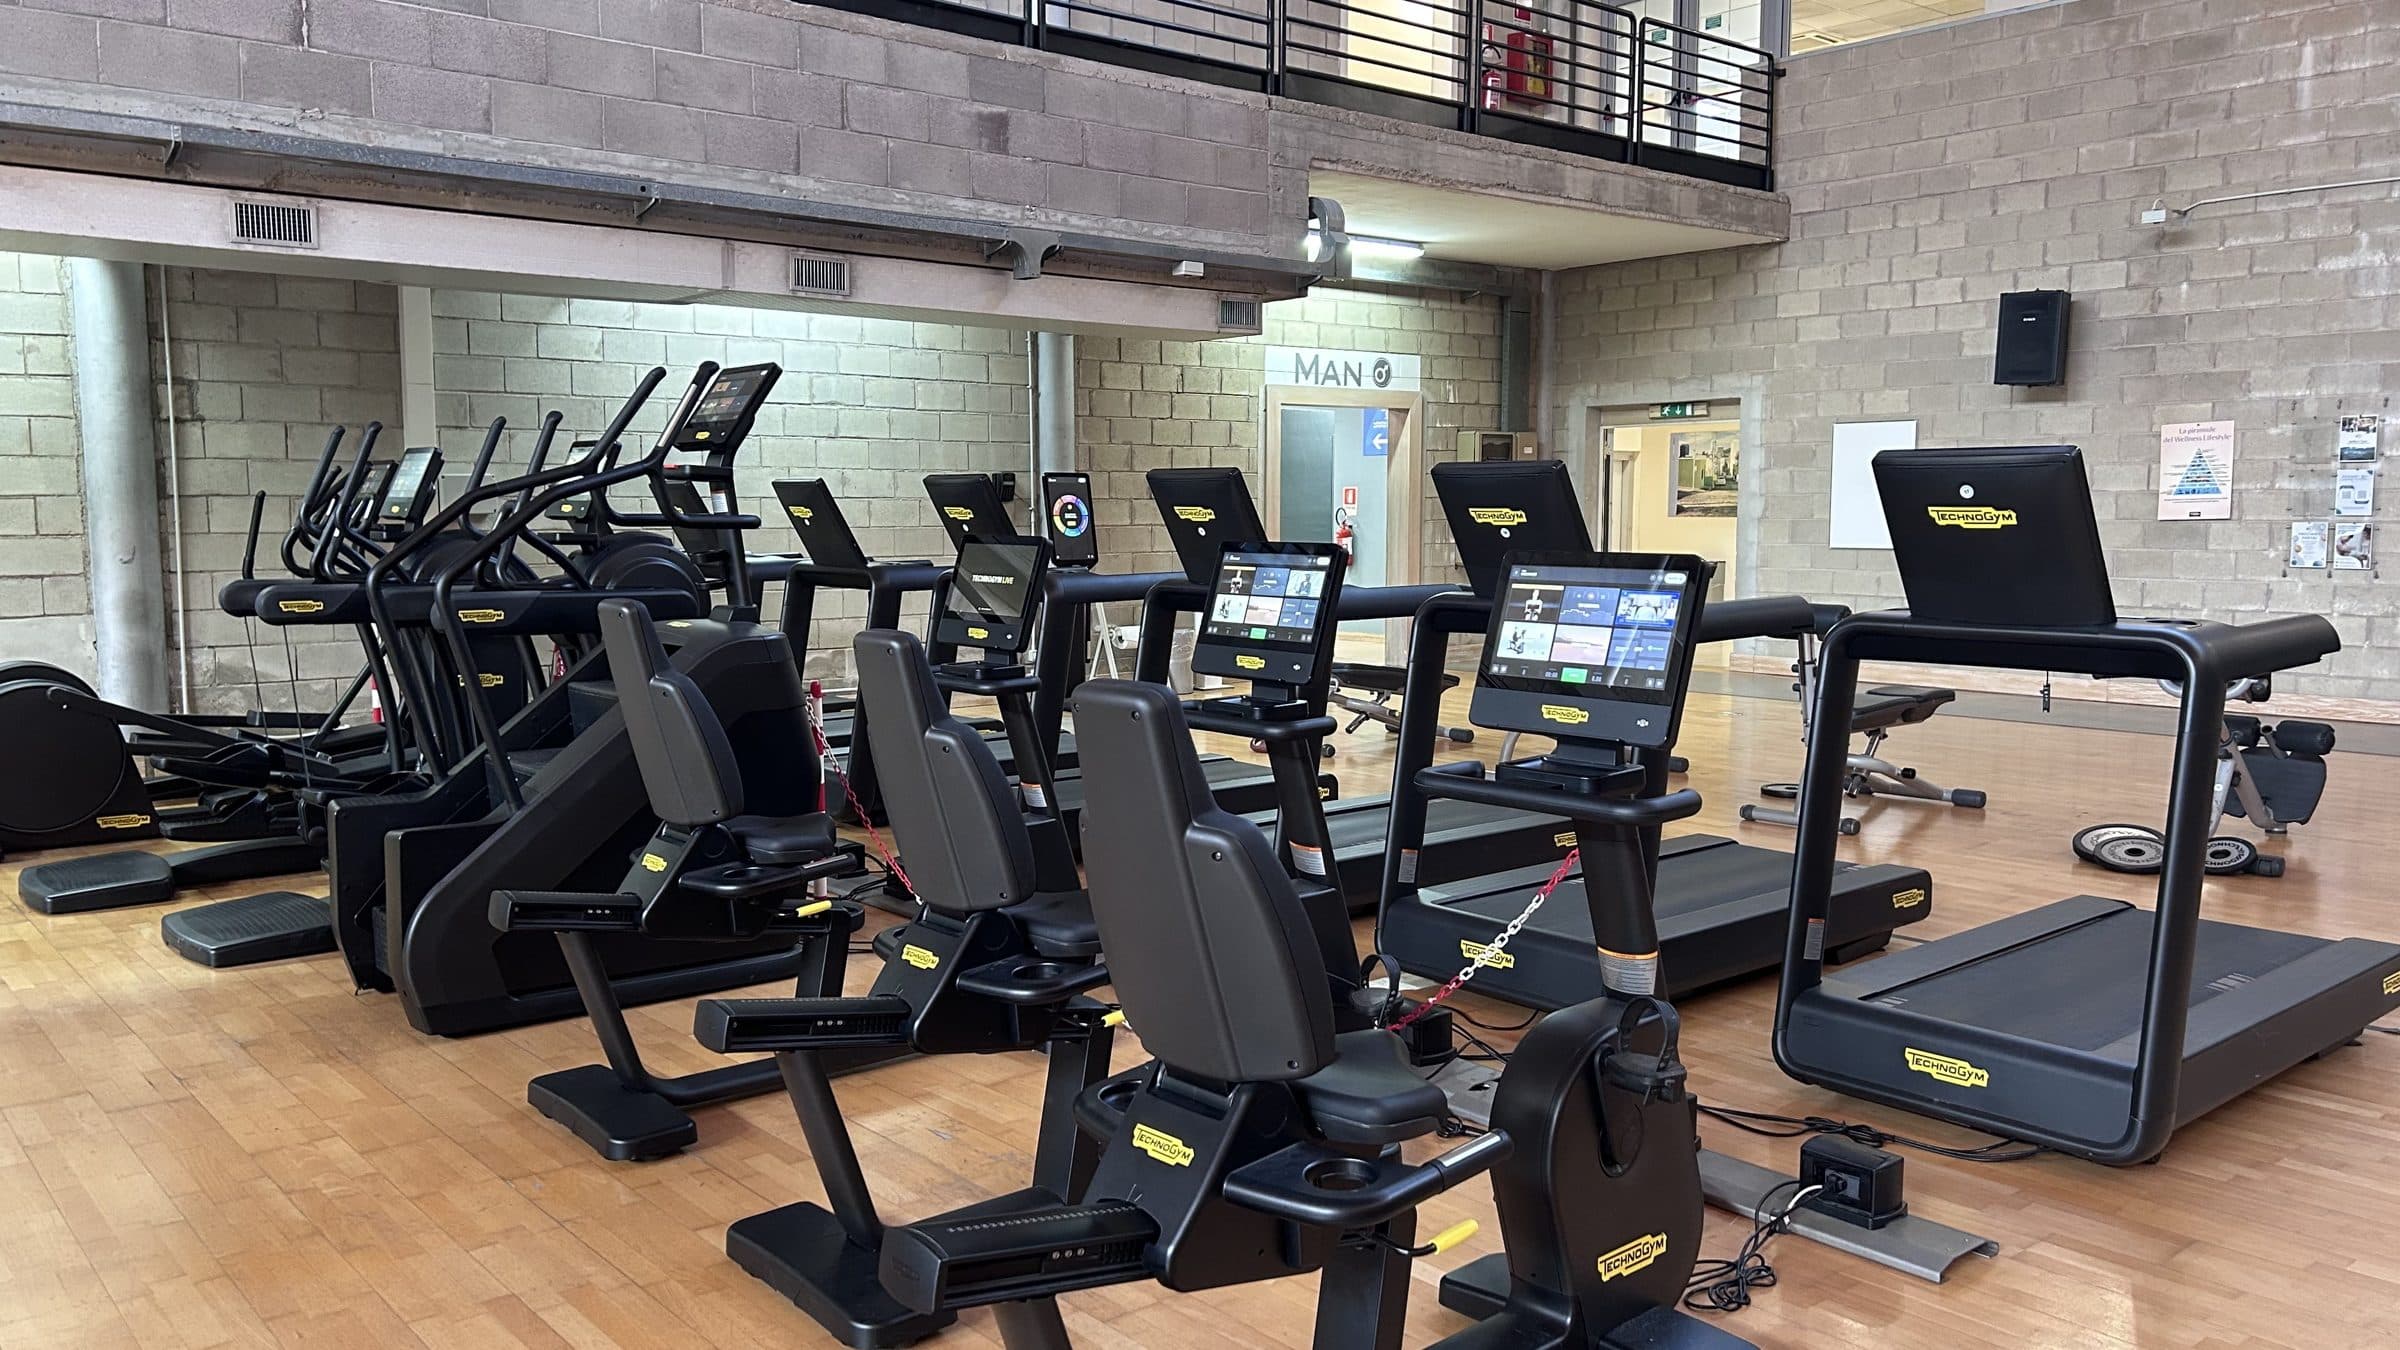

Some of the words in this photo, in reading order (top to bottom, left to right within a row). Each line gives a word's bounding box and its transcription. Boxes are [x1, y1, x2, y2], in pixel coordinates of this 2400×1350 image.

[1295, 352, 1362, 387] MAN
[1931, 509, 2014, 527] TECHNOGYM
[1463, 942, 1513, 967] TECHGYM
[1907, 1049, 1986, 1086] TECHNOGYM
[1134, 1125, 1193, 1165] TECHNOGYM
[1599, 1235, 1667, 1281] TECHNOGYM
